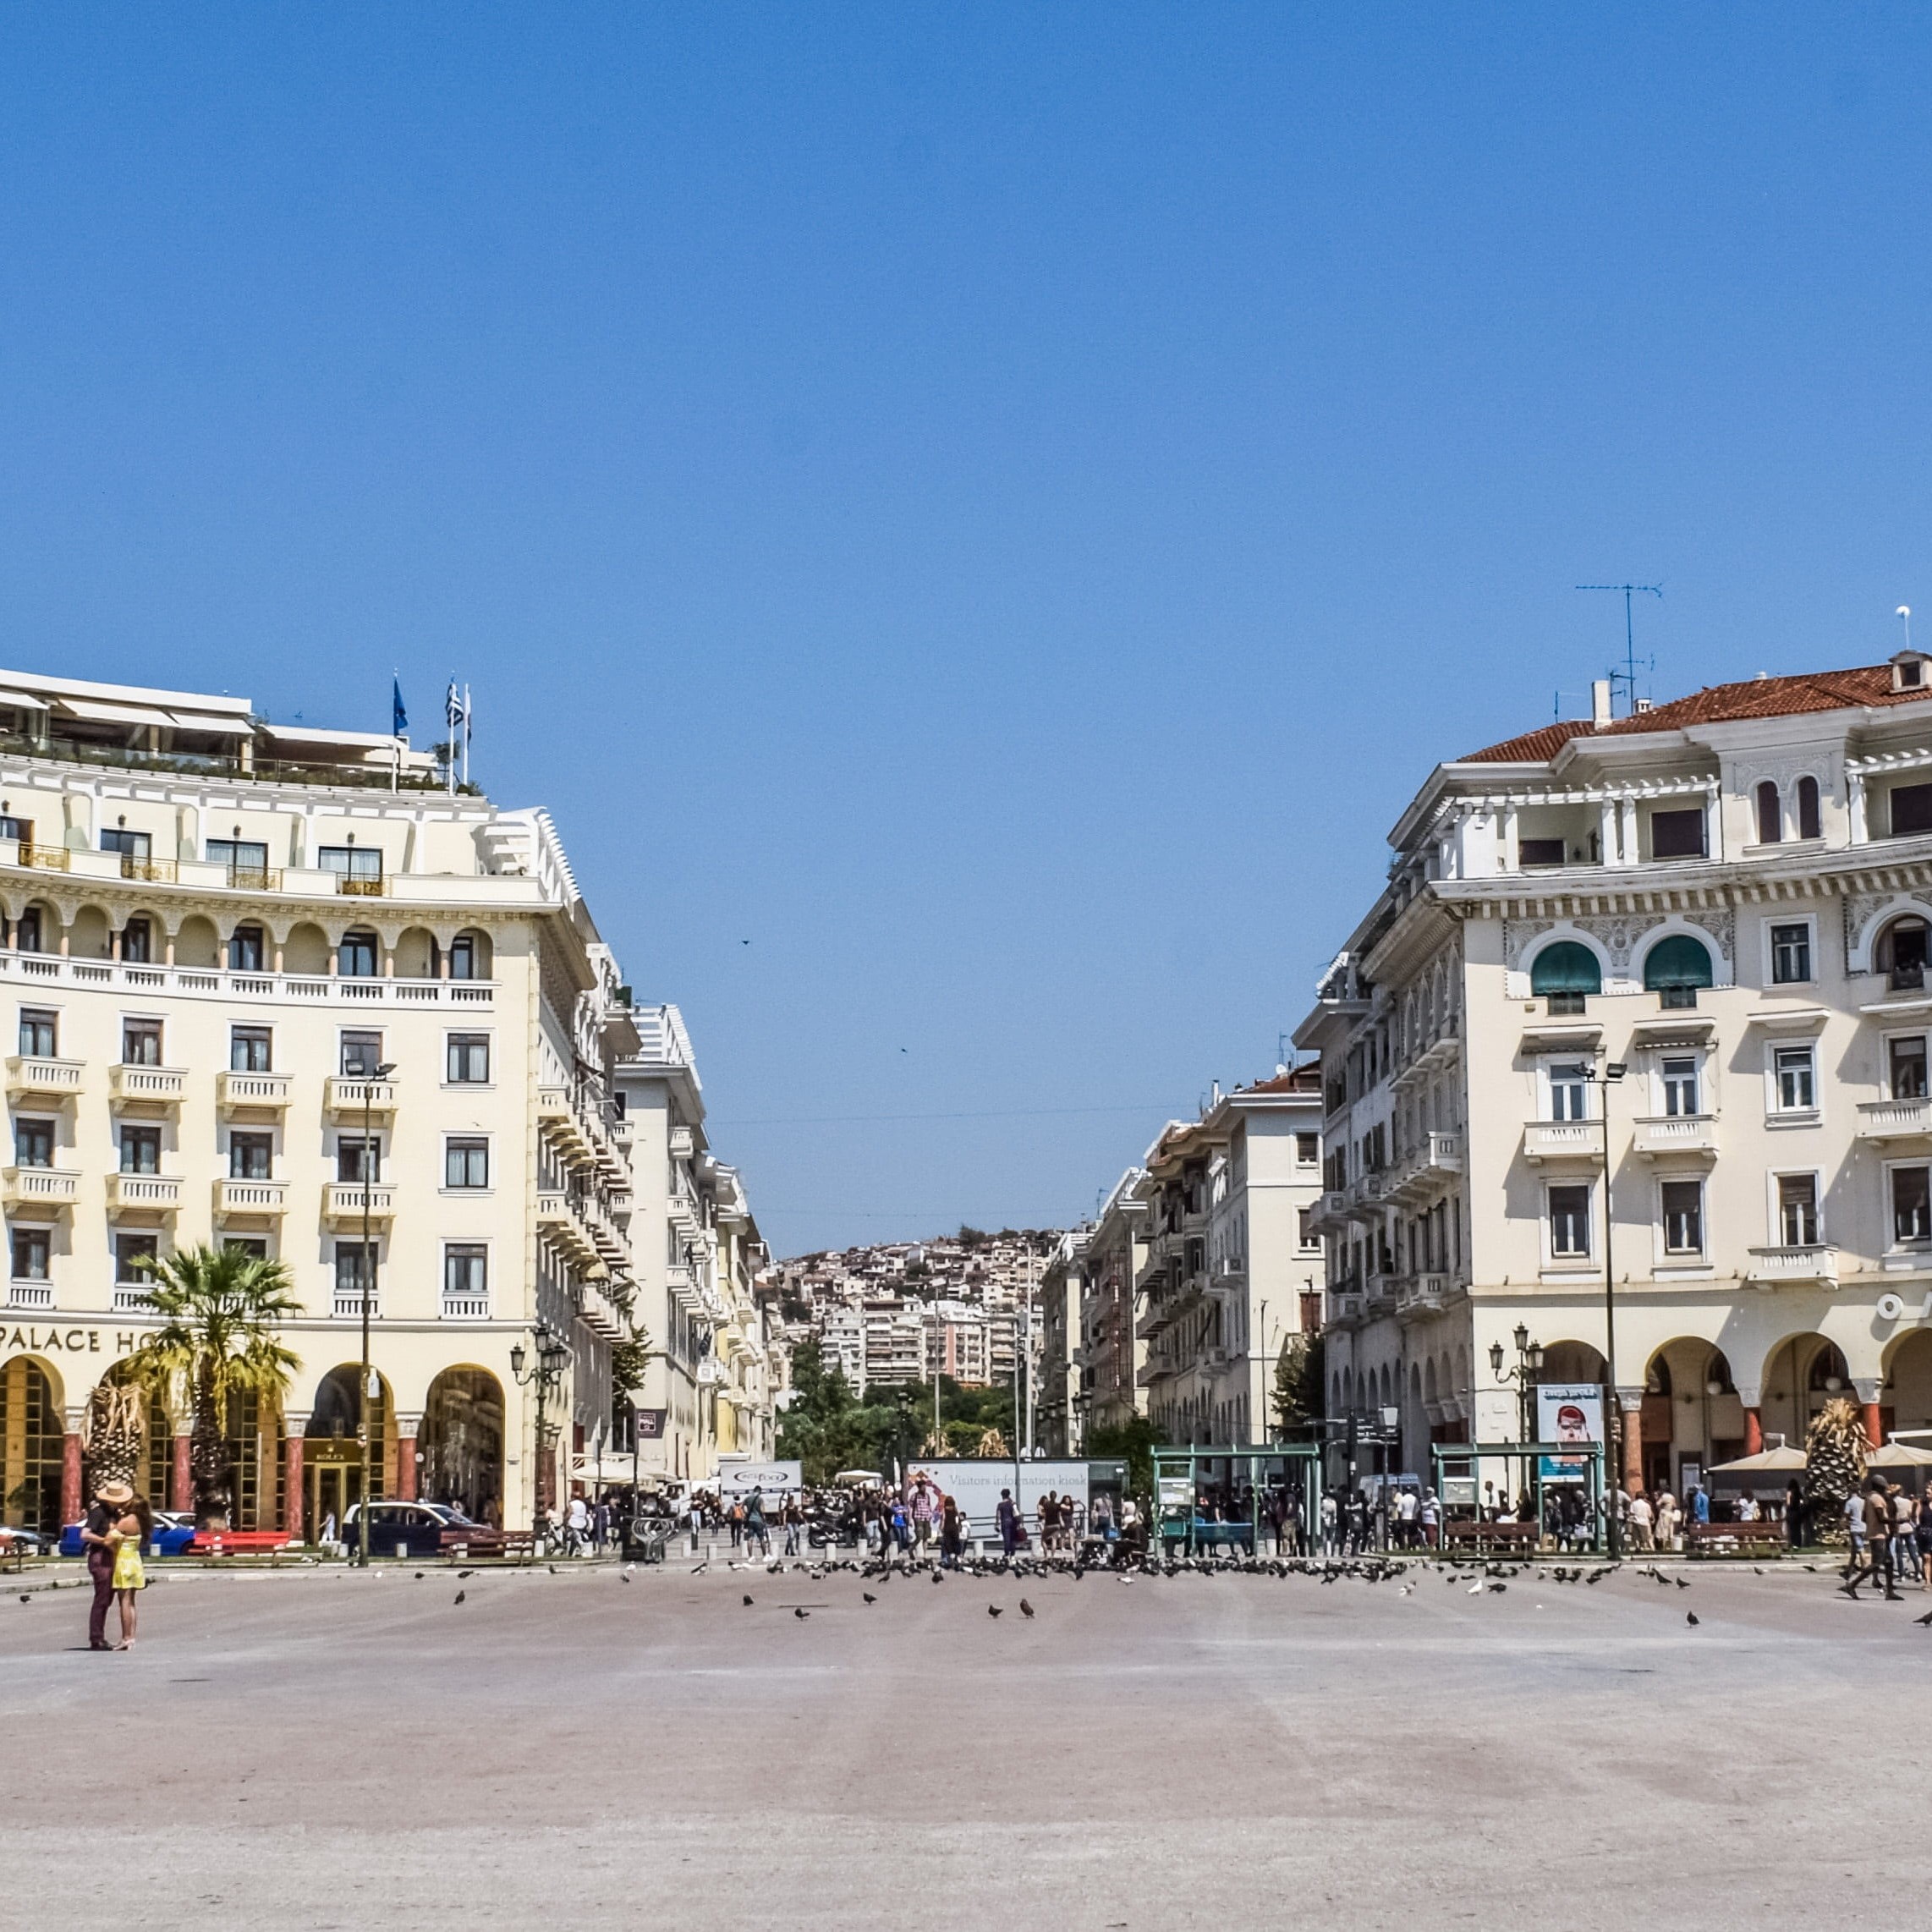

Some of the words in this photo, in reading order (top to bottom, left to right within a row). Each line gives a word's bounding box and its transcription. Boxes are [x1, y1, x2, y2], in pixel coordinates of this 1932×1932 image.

[0, 1326, 100, 1352] PALACE
[950, 1474, 991, 1486] Visitors
[993, 1474, 1056, 1486] infomation
[1059, 1474, 1087, 1486] kiosk
